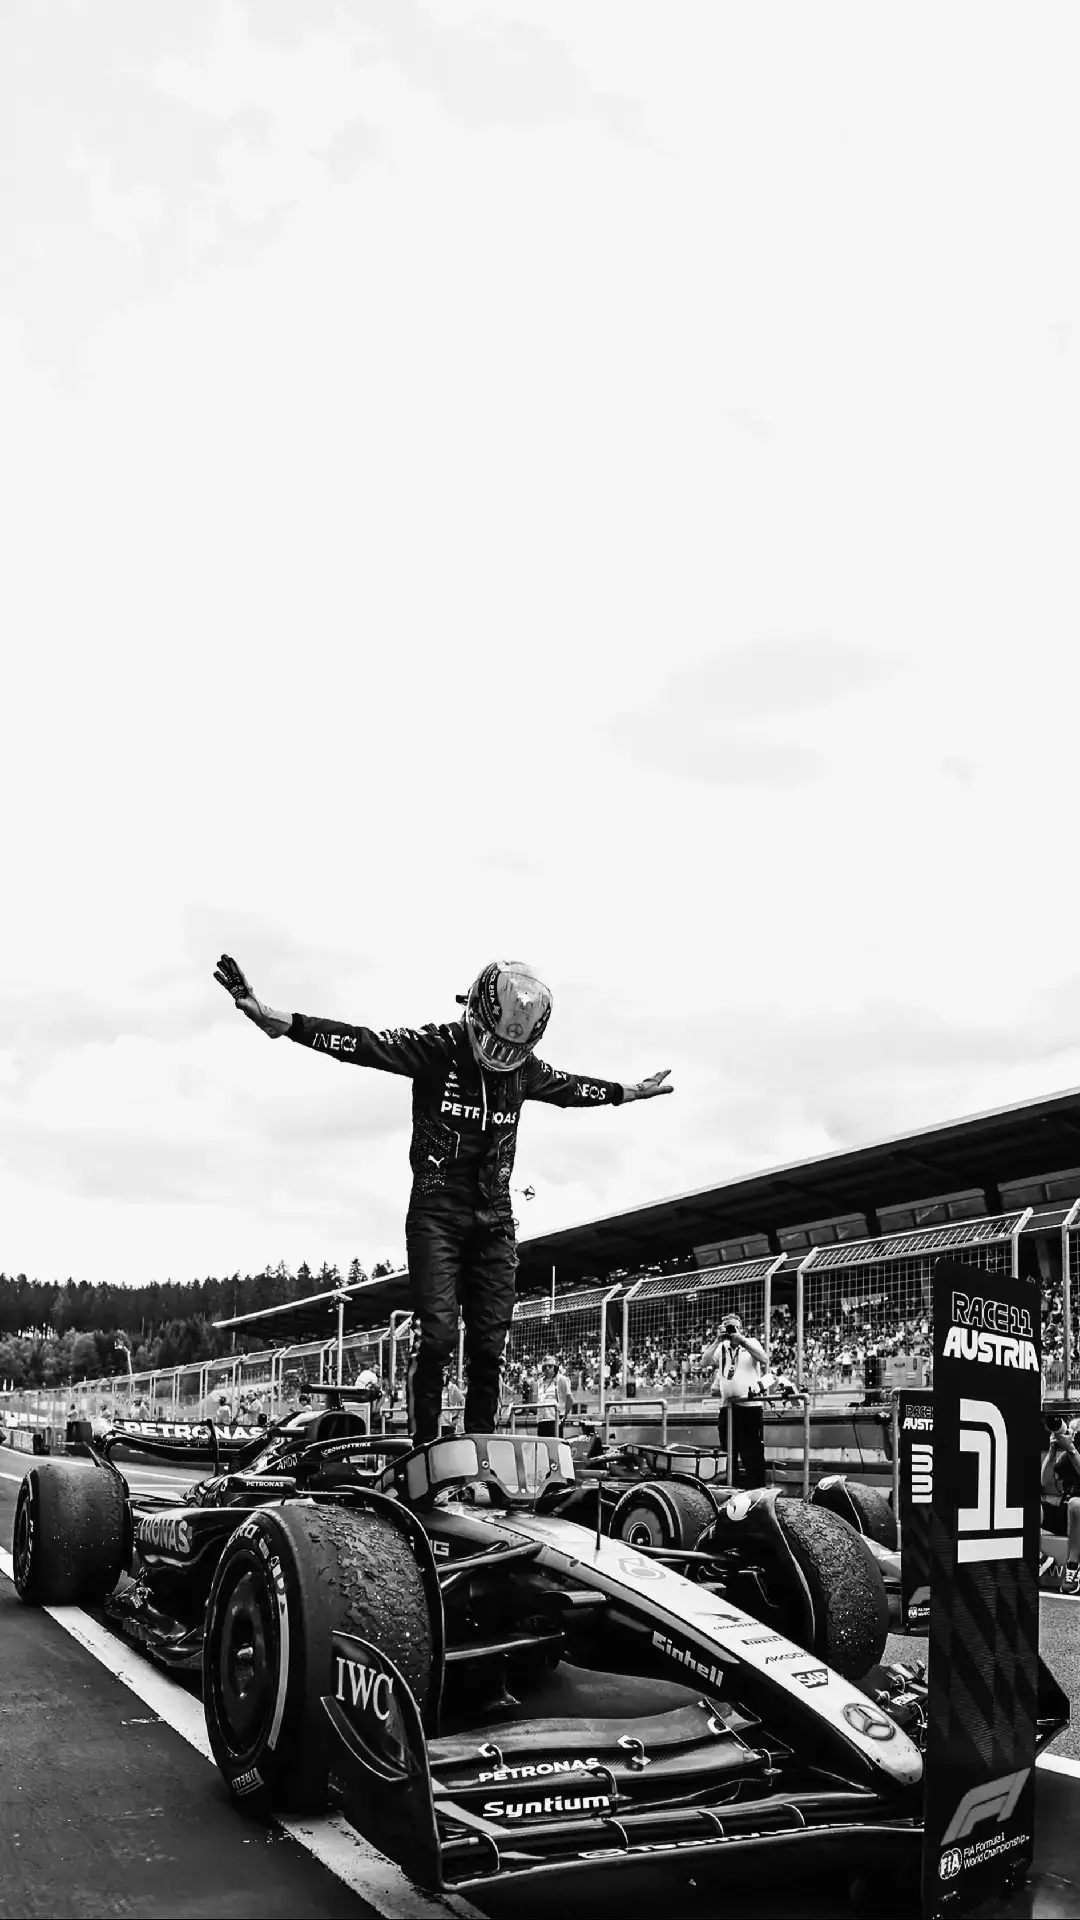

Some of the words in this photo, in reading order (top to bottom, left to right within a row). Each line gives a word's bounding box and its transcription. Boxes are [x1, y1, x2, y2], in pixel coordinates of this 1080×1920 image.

[942, 1326, 1040, 1373] AUSTRIA
[958, 1398, 1024, 1564] 1
[652, 1630, 724, 1687] Einhell
[335, 1656, 394, 1721] IWC
[795, 1670, 828, 1686] SAP
[478, 1757, 601, 1783] PETRONAS
[482, 1795, 610, 1819] Syntium
[940, 1852, 960, 1876] FIA
